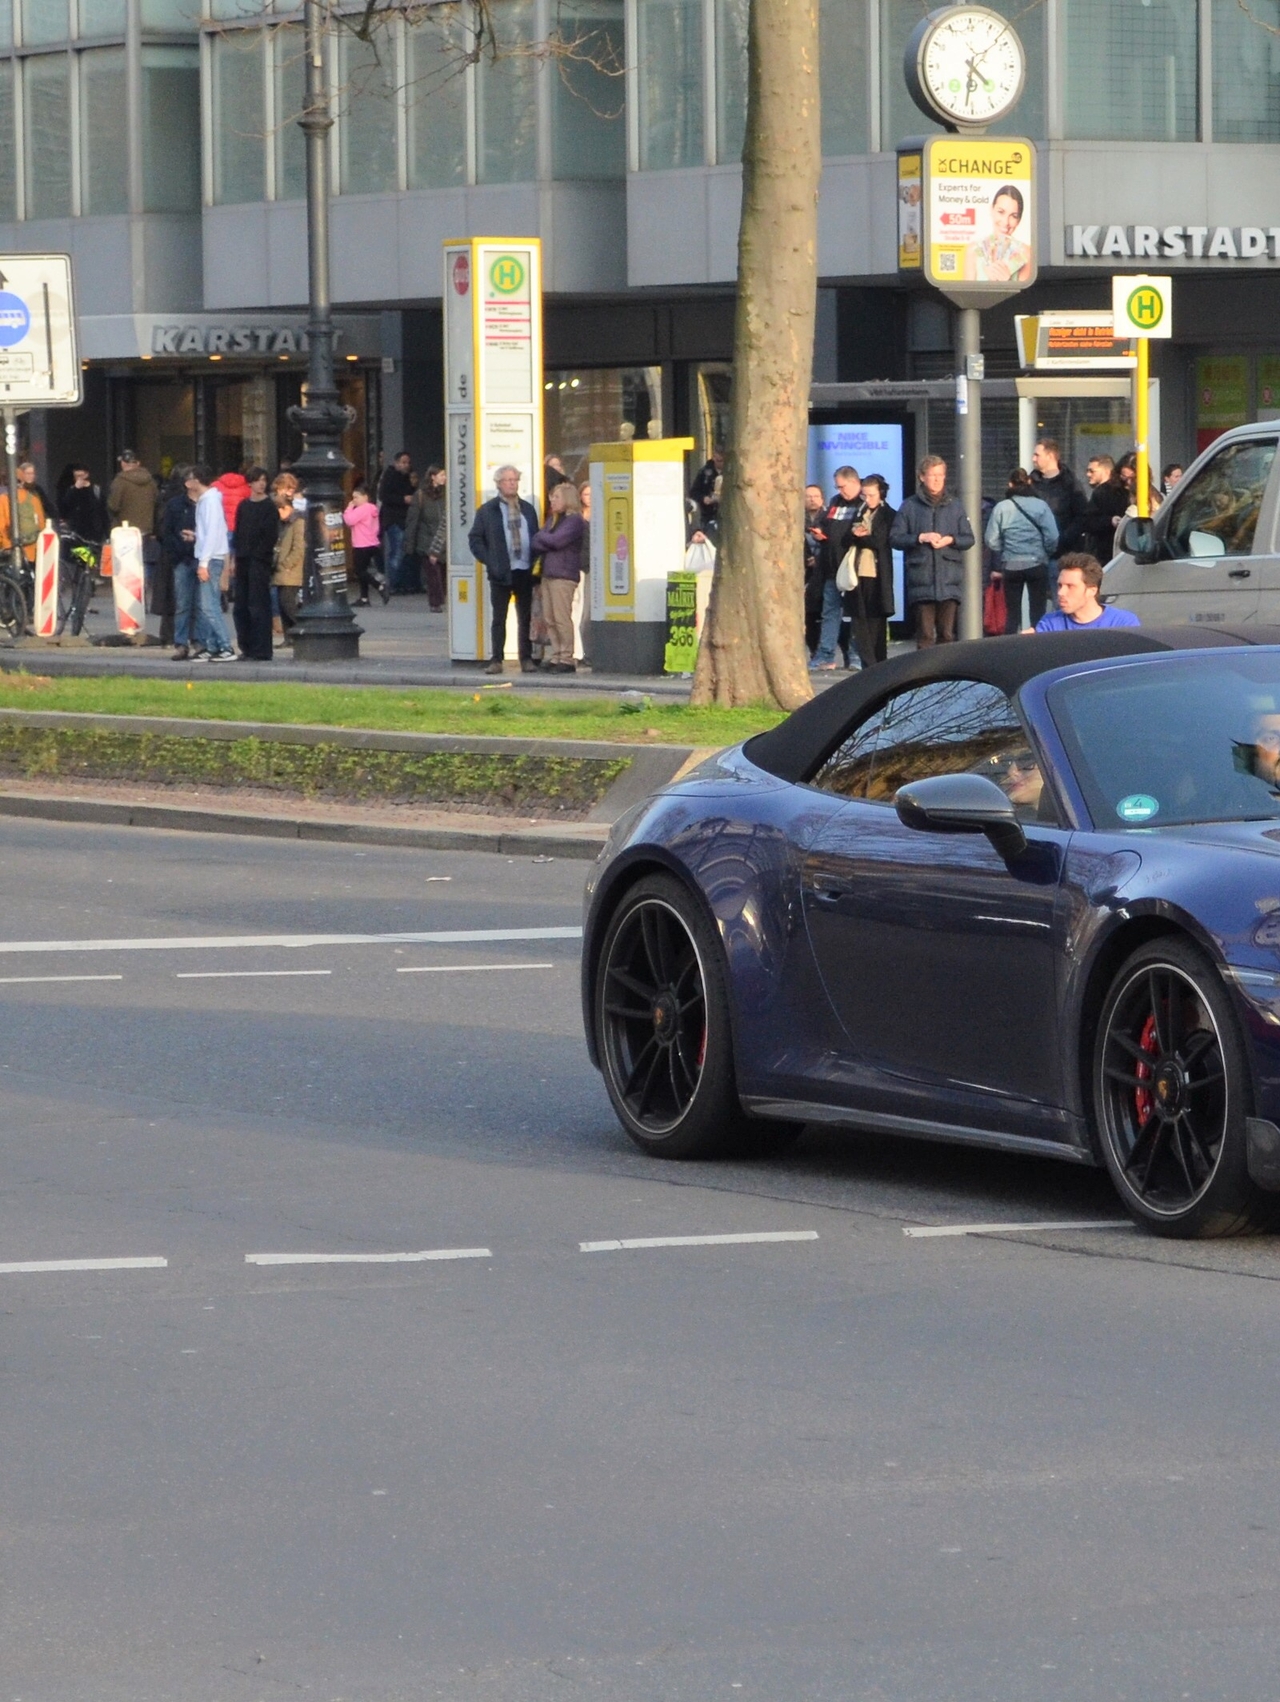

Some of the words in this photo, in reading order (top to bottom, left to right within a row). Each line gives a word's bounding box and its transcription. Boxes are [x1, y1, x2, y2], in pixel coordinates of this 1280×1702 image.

[948, 159, 1013, 175] CHANGE
[938, 183, 968, 193] Experts
[969, 183, 981, 192] for
[938, 195, 963, 204] Money
[965, 196, 971, 204] &
[972, 196, 989, 204] Gold
[949, 214, 971, 225] 50m
[500, 264, 515, 285] H
[1137, 295, 1154, 319] H
[153, 325, 343, 352] KARSTAT
[837, 432, 869, 441] NIKE
[818, 441, 889, 450] INVINCIBLE
[1133, 798, 1142, 808] 4
